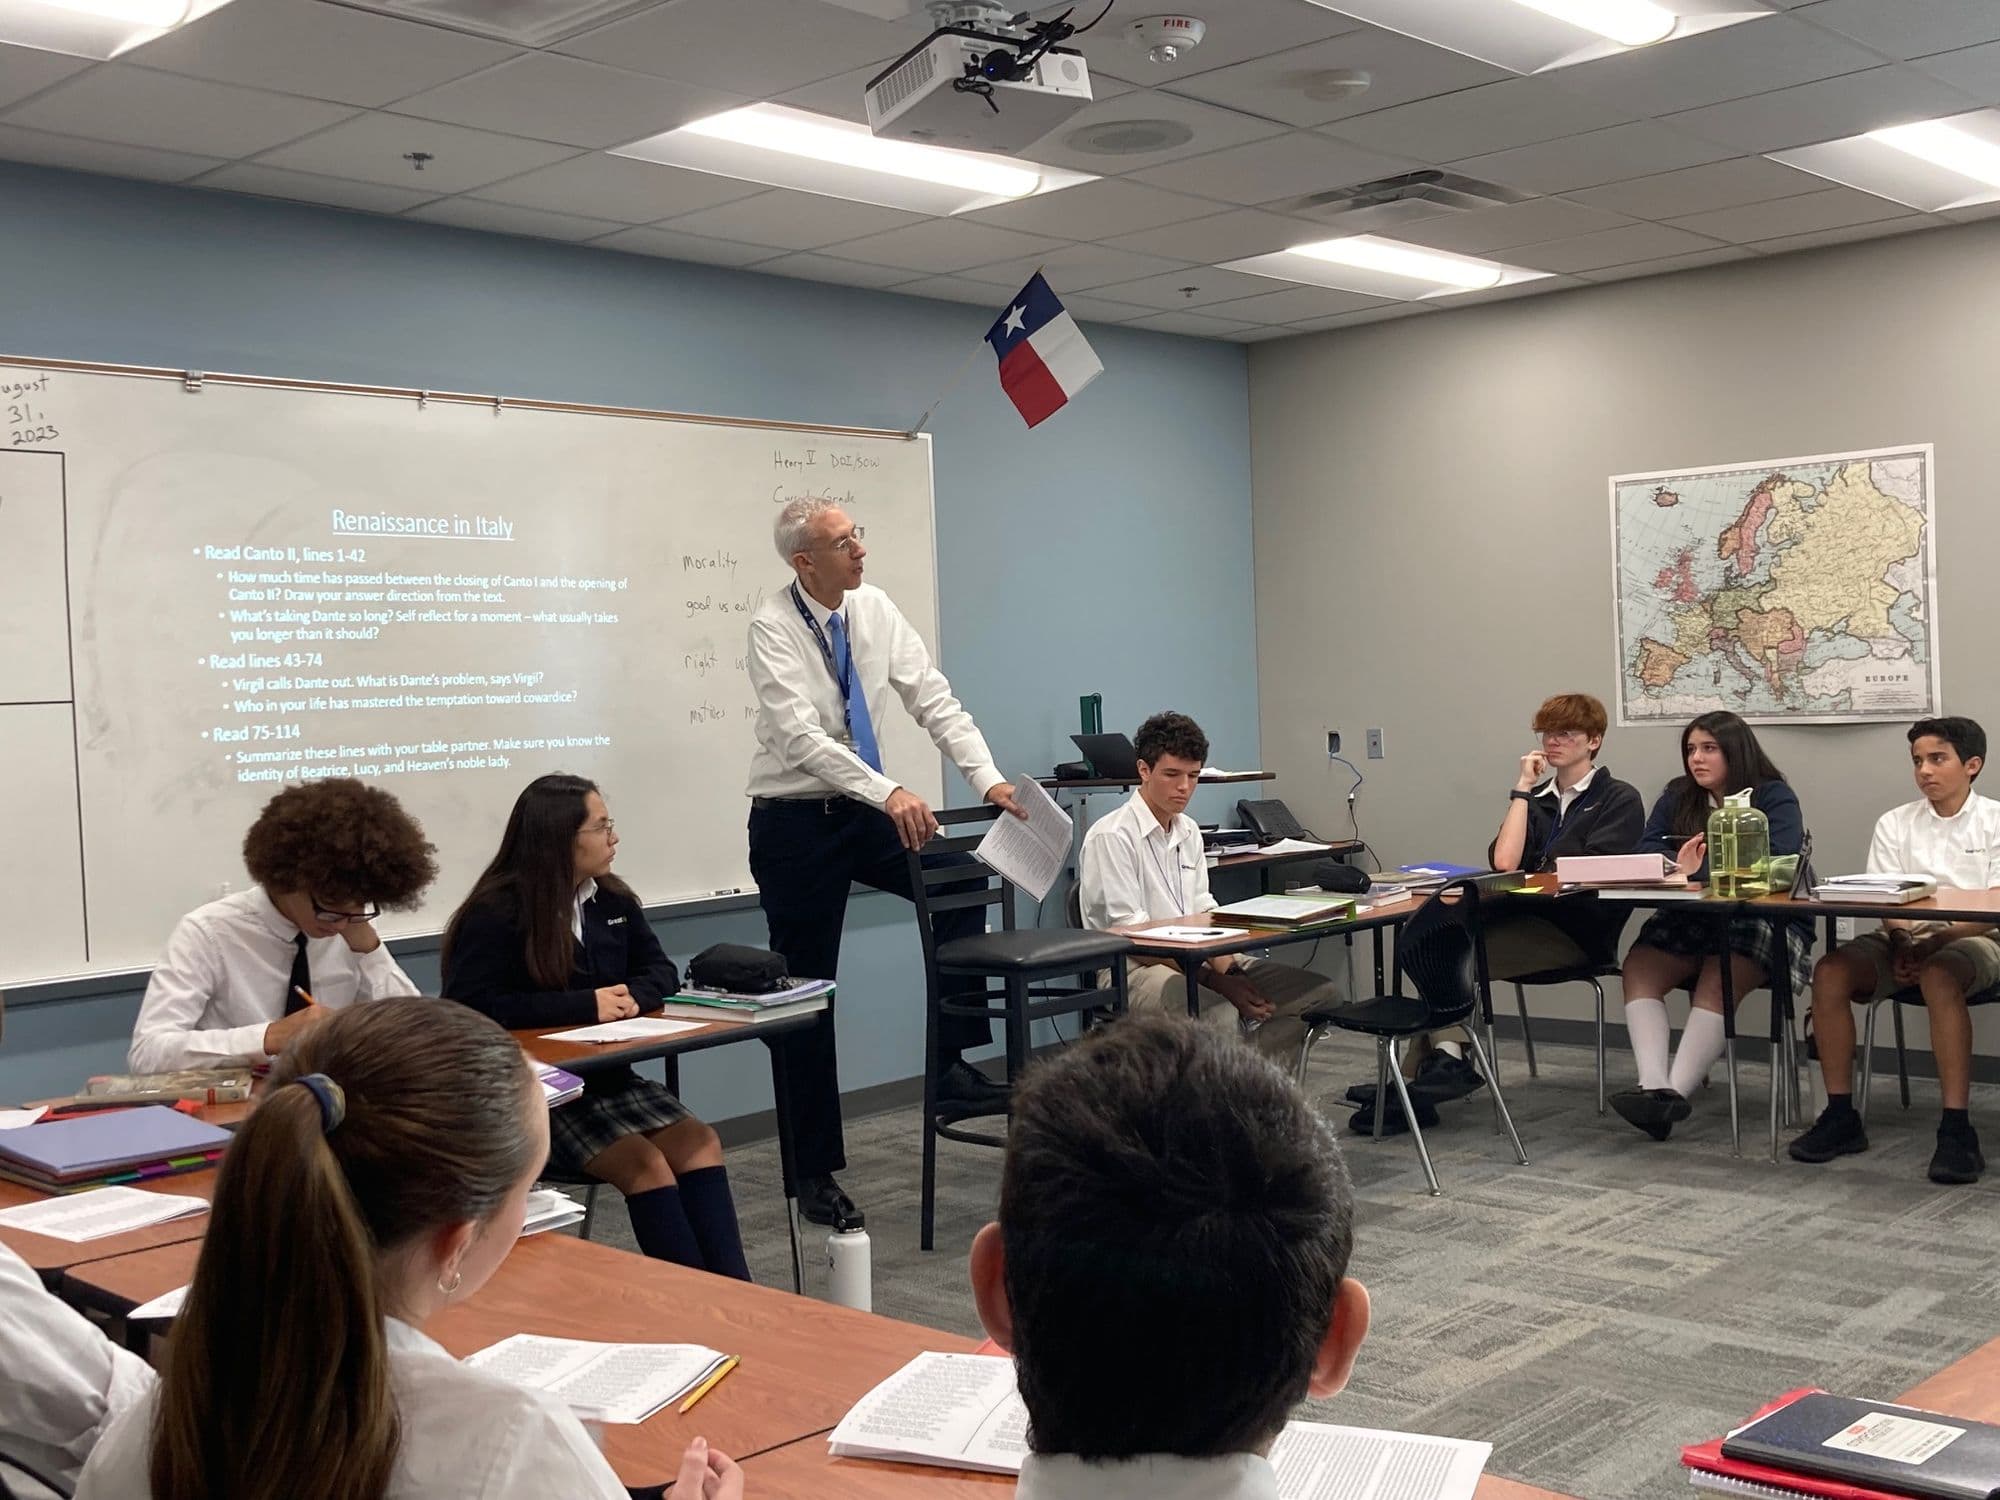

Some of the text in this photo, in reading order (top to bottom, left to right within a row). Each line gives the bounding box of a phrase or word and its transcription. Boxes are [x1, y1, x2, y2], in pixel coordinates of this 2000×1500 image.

[1164, 19, 1190, 29] FIRE
[0, 373, 50, 399] ugust
[12, 425, 60, 446] 2023
[332, 509, 514, 540] Renaissance in Italy
[204, 545, 366, 564] Read Canto II, lines 1-42
[228, 571, 257, 584] How
[258, 571, 292, 584] much
[294, 572, 320, 584] time
[322, 572, 342, 584] has
[345, 573, 383, 588] passed
[385, 573, 432, 586] between
[434, 574, 450, 586] the
[454, 574, 489, 589] closing
[491, 575, 502, 587] of
[504, 577, 534, 588] Canto
[540, 576, 558, 588] and
[560, 576, 576, 588] the
[578, 577, 616, 592] opening
[618, 577, 628, 590] of
[228, 588, 506, 604] Canto II? Draw your answer direction from the text.
[230, 609, 272, 622] What's
[274, 609, 311, 626] taking
[312, 610, 346, 622] Dante
[349, 613, 362, 622] so
[364, 610, 394, 625] long?
[396, 610, 416, 622] Self
[418, 610, 452, 622] reflect
[454, 610, 468, 622] for
[470, 614, 478, 622] a
[480, 612, 522, 623] moment
[532, 611, 557, 624] what
[559, 612, 592, 626] usually
[594, 612, 618, 624] takes
[230, 628, 380, 644] you longer than it should?
[210, 653, 324, 669] Read lines 43-74
[233, 672, 544, 694] Virgil calls Dante out. What is Dante's problem, says Virgil?
[234, 690, 578, 714] Who in your life has mastered the temptation toward cowardice?
[213, 724, 300, 742] Read 75-114
[236, 734, 610, 764] Summarize these lines with your table partner. Make sure you know the
[238, 755, 512, 783] identity of Beatrice, Lucy, and Heaven's noble lady.
